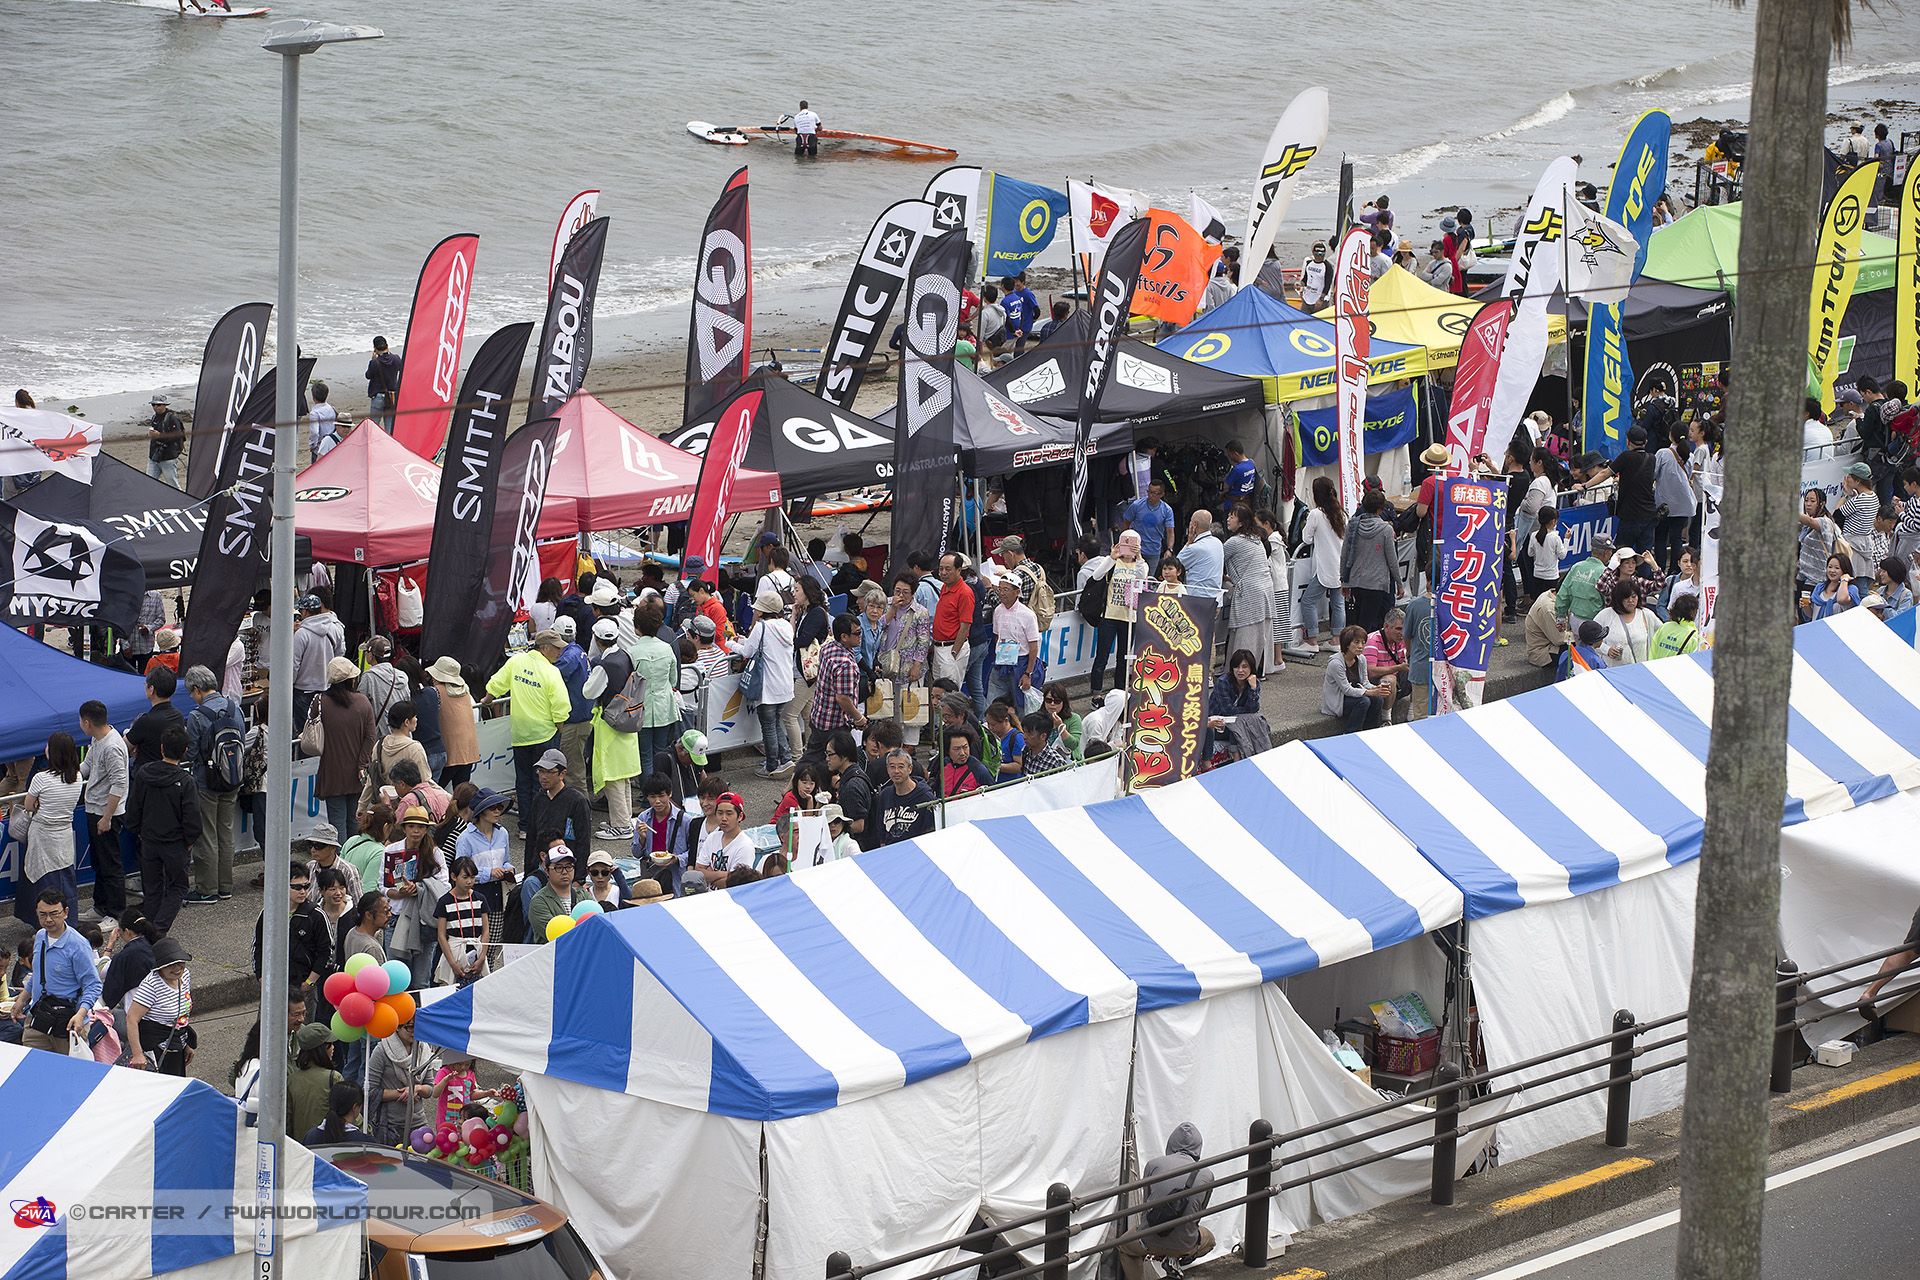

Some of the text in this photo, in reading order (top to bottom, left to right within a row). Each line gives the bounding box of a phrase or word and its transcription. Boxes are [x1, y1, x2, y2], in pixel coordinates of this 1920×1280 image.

[542, 273, 585, 404] TABOU
[218, 422, 276, 559] SMITH
[452, 388, 502, 523] SMITH
[647, 492, 696, 517] FANA
[1452, 485, 1490, 504] 新名産
[8, 594, 100, 619] MYSTIC
[1441, 505, 1491, 662] アカモク
[1478, 488, 1508, 666] おいしくヘルシー
[1180, 663, 1204, 781] 鳥と炎とタレ
